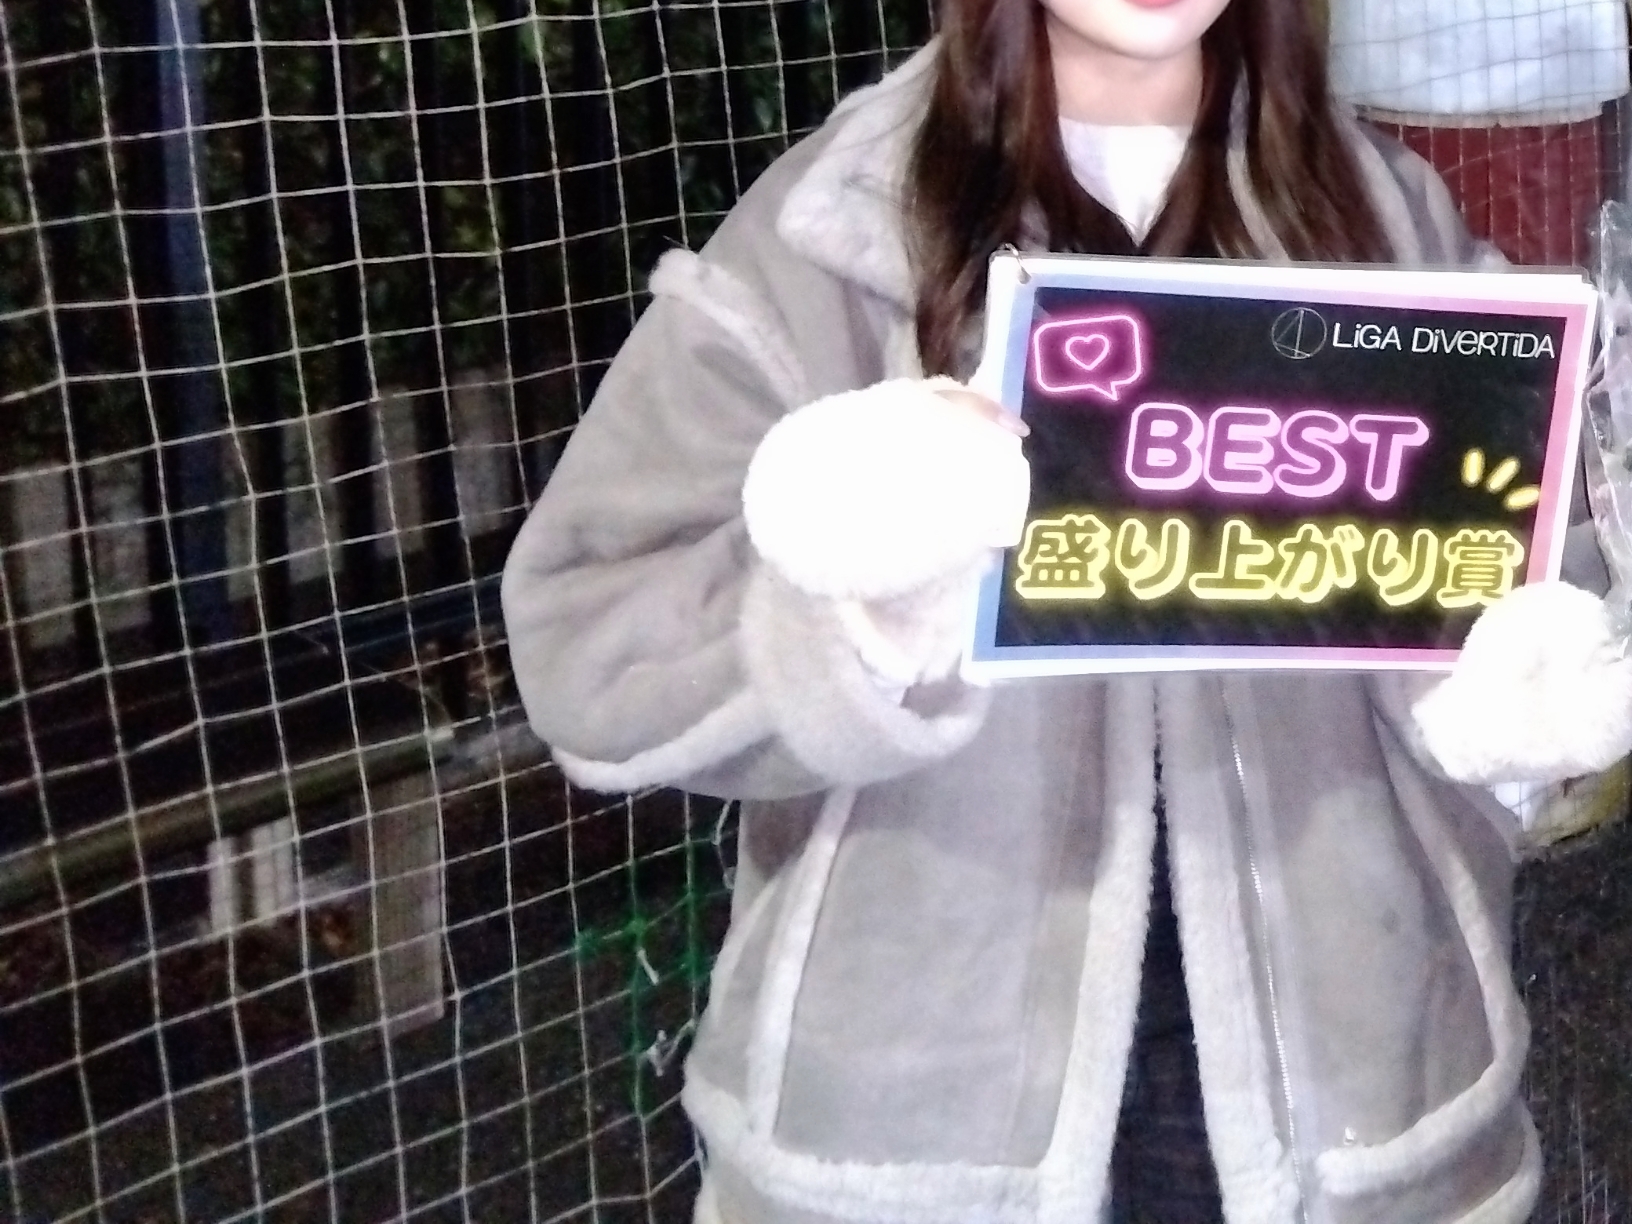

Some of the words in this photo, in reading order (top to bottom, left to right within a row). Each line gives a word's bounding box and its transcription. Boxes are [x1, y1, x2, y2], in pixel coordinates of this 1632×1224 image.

[1126, 403, 1429, 501] BEST
[1016, 514, 1525, 608] 盛り上がり賞
